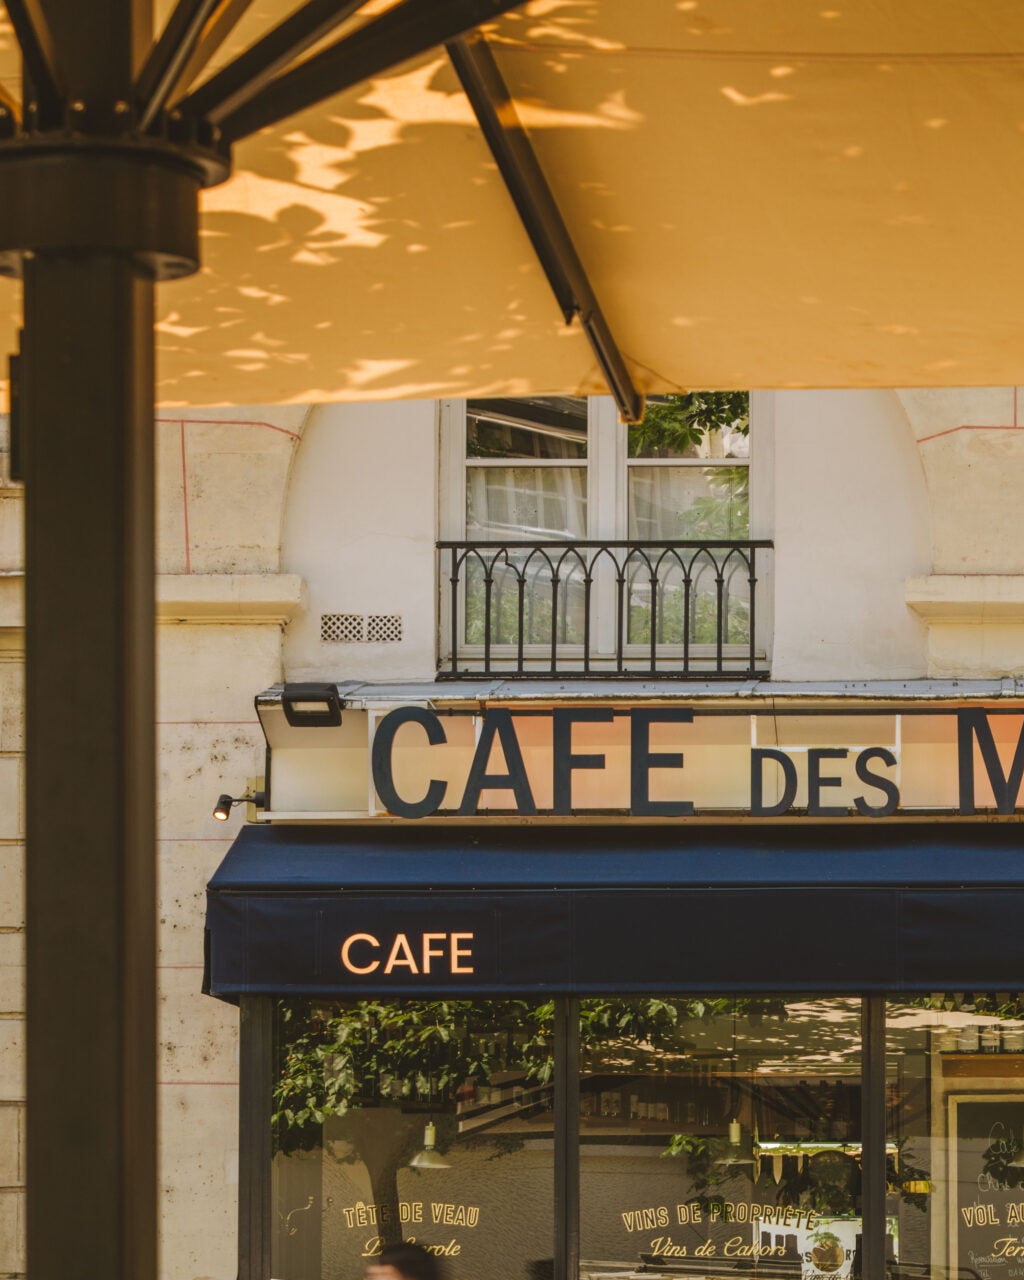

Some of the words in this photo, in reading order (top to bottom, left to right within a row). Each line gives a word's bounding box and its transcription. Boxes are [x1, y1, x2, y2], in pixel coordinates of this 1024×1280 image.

[371, 705, 695, 820] CAFE
[750, 746, 898, 819] DES
[340, 932, 475, 975] CAFE
[343, 1201, 389, 1228] TÊTE
[399, 1202, 423, 1223] DE
[431, 1202, 480, 1227] VEAU
[621, 1206, 670, 1232] VINS
[677, 1203, 703, 1225] DE
[710, 1202, 818, 1231] PROPRIÉTÉ
[961, 1204, 1000, 1228] VOL
[650, 1236, 687, 1257] Vins
[694, 1238, 717, 1257] de
[723, 1236, 787, 1258] Cahors
